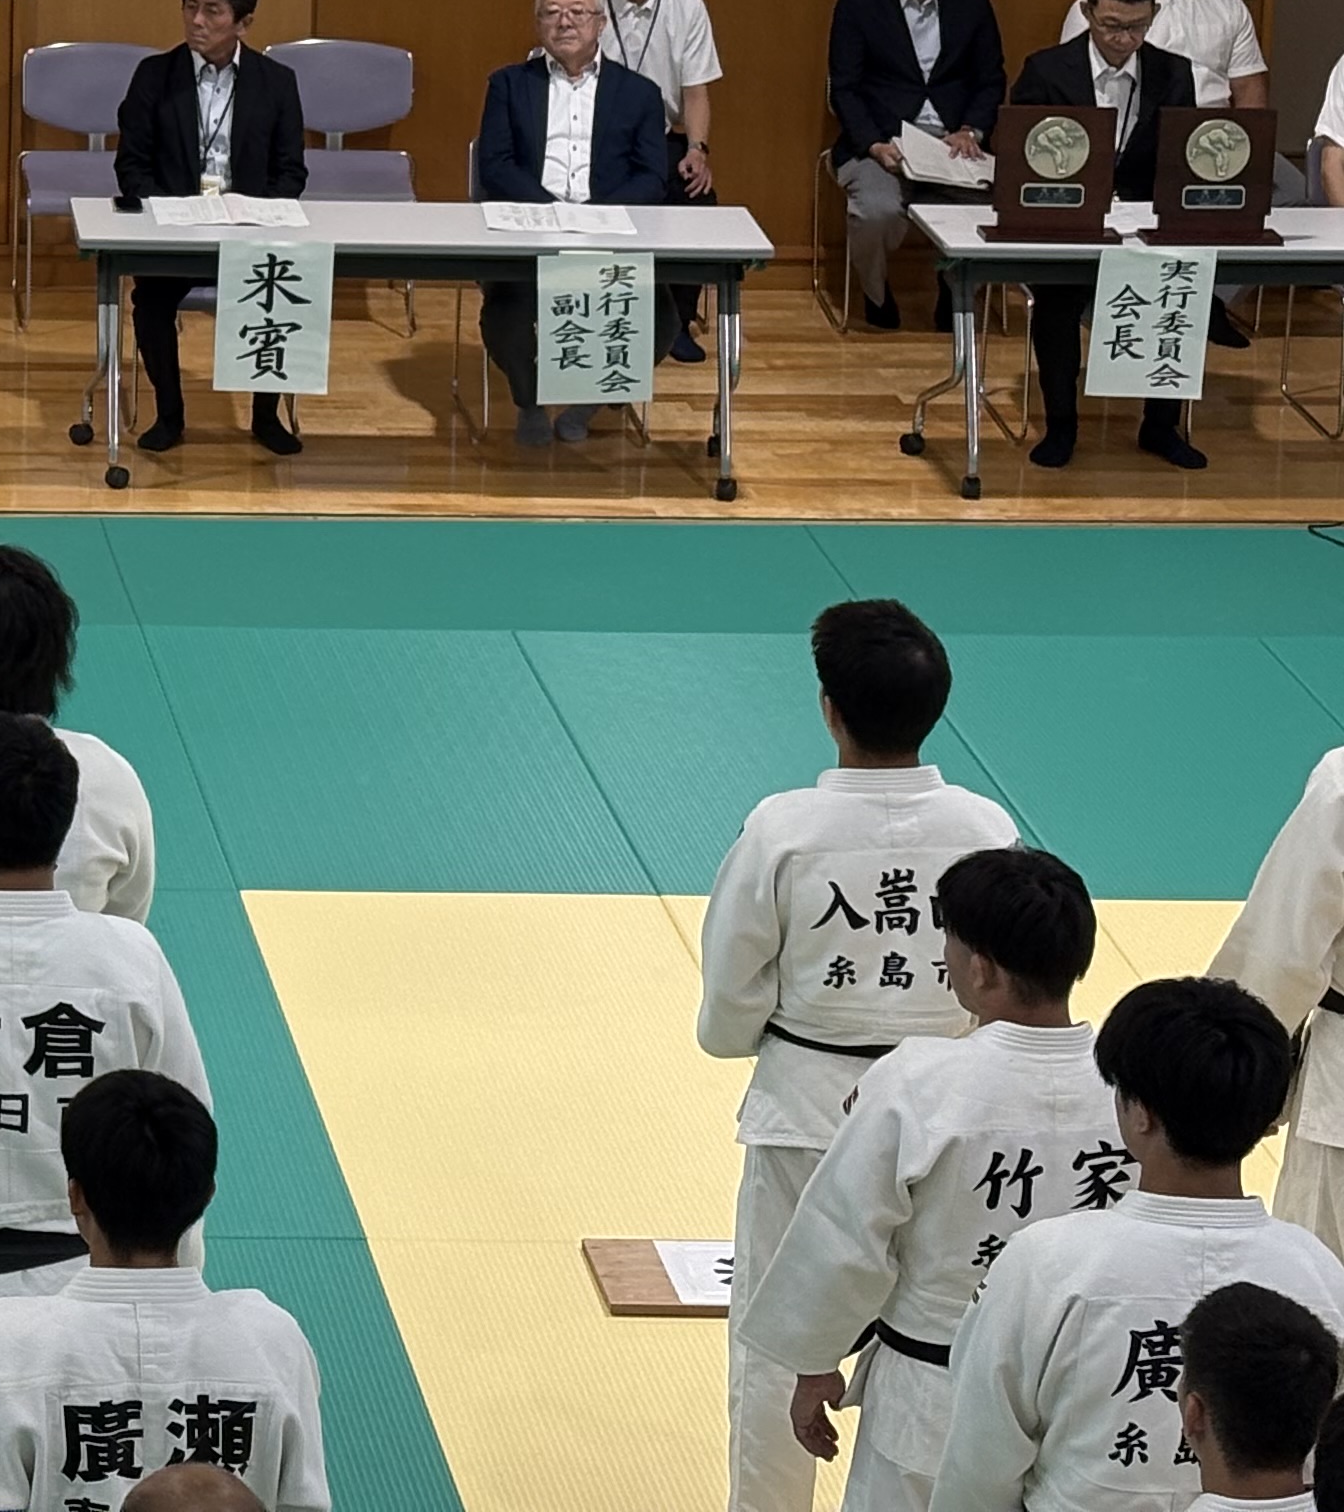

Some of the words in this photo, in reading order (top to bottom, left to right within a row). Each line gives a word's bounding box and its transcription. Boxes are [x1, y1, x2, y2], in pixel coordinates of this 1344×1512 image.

[236, 252, 312, 381] 来賓
[550, 292, 595, 371] 副会長
[596, 264, 641, 393] 実行委員会
[1103, 283, 1152, 361] 会長
[1145, 259, 1199, 389] 実行委員会
